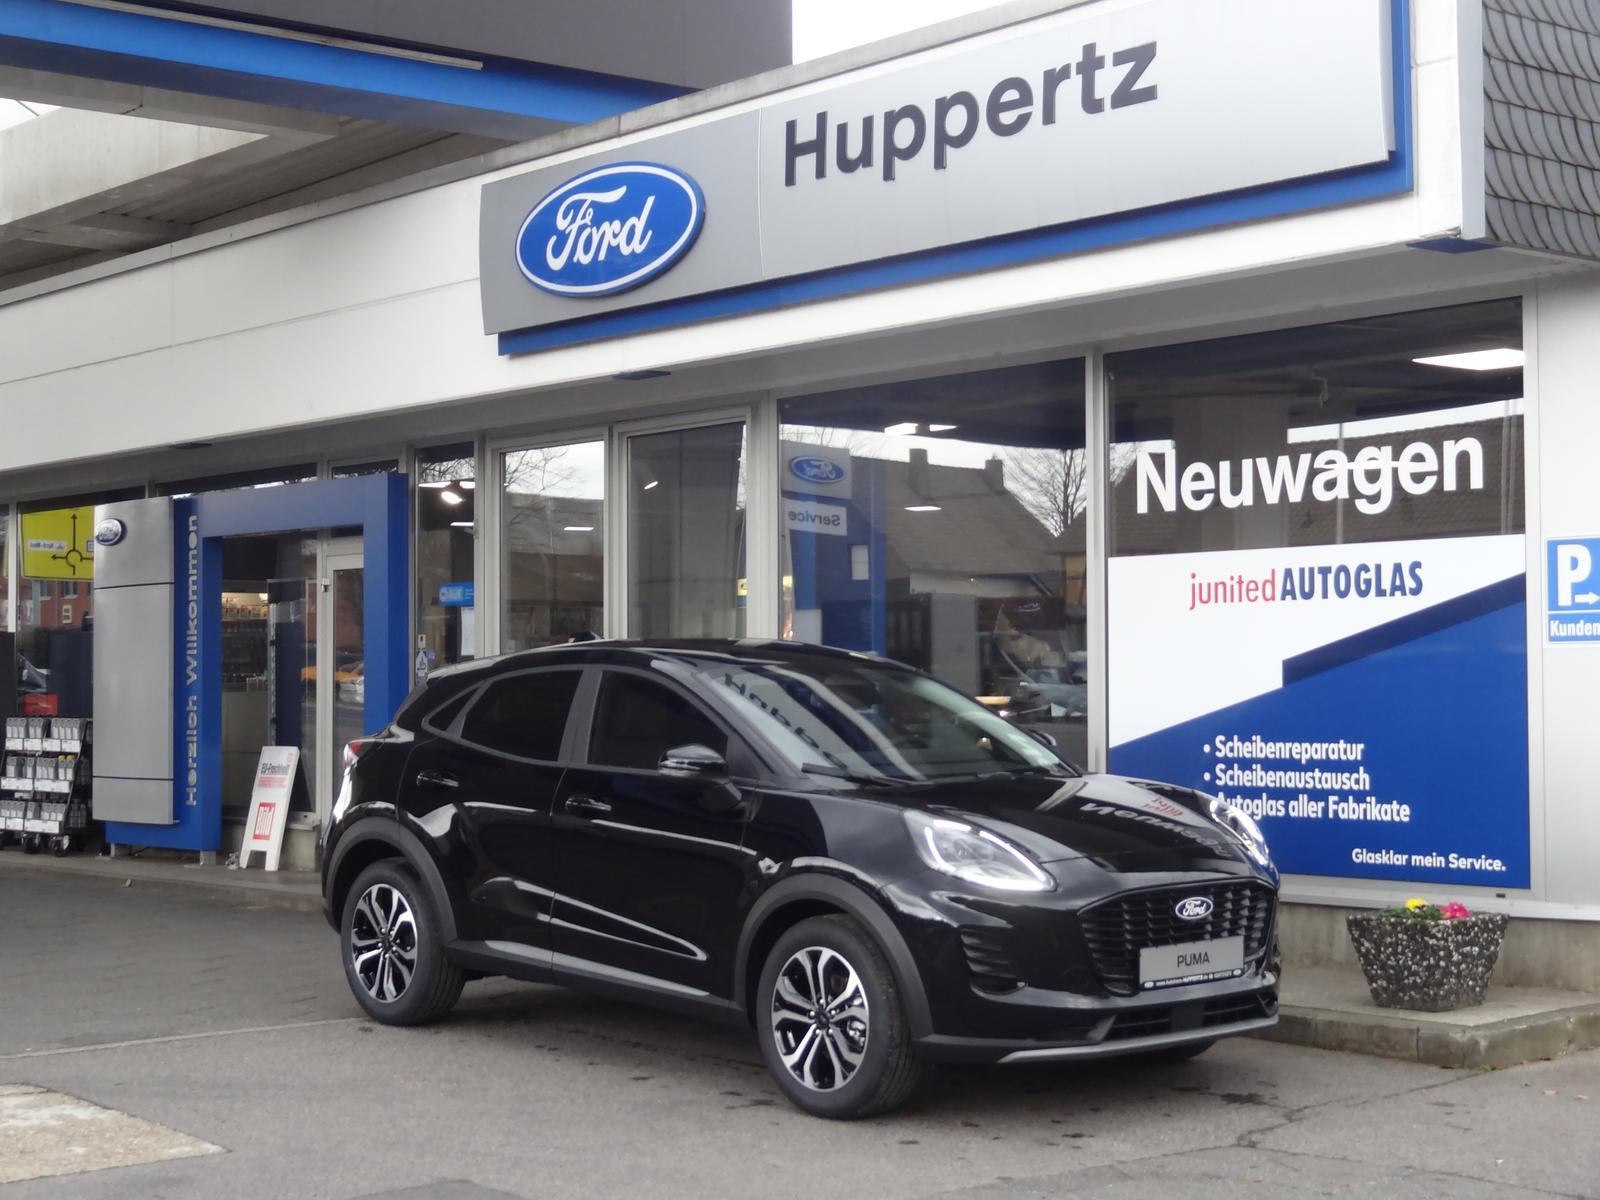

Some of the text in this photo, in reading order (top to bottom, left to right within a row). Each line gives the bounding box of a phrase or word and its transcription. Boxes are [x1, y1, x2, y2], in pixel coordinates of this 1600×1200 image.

[784, 41, 1159, 187] Huppertz
[546, 185, 656, 271] Ford
[1135, 436, 1484, 515] Neuwagen
[1189, 560, 1424, 610] junited AUTOGLAS
[1557, 544, 1592, 606] P
[1550, 619, 1600, 636] Kunden
[1215, 735, 1365, 764] Scheibenreparatur
[1215, 763, 1370, 791] Scheibenaustausch
[1288, 793, 1325, 819] aller
[1328, 795, 1411, 822] Fabrikate
[1351, 847, 1507, 872] Glasklar mein Service.
[1177, 951, 1210, 968] PUMA
